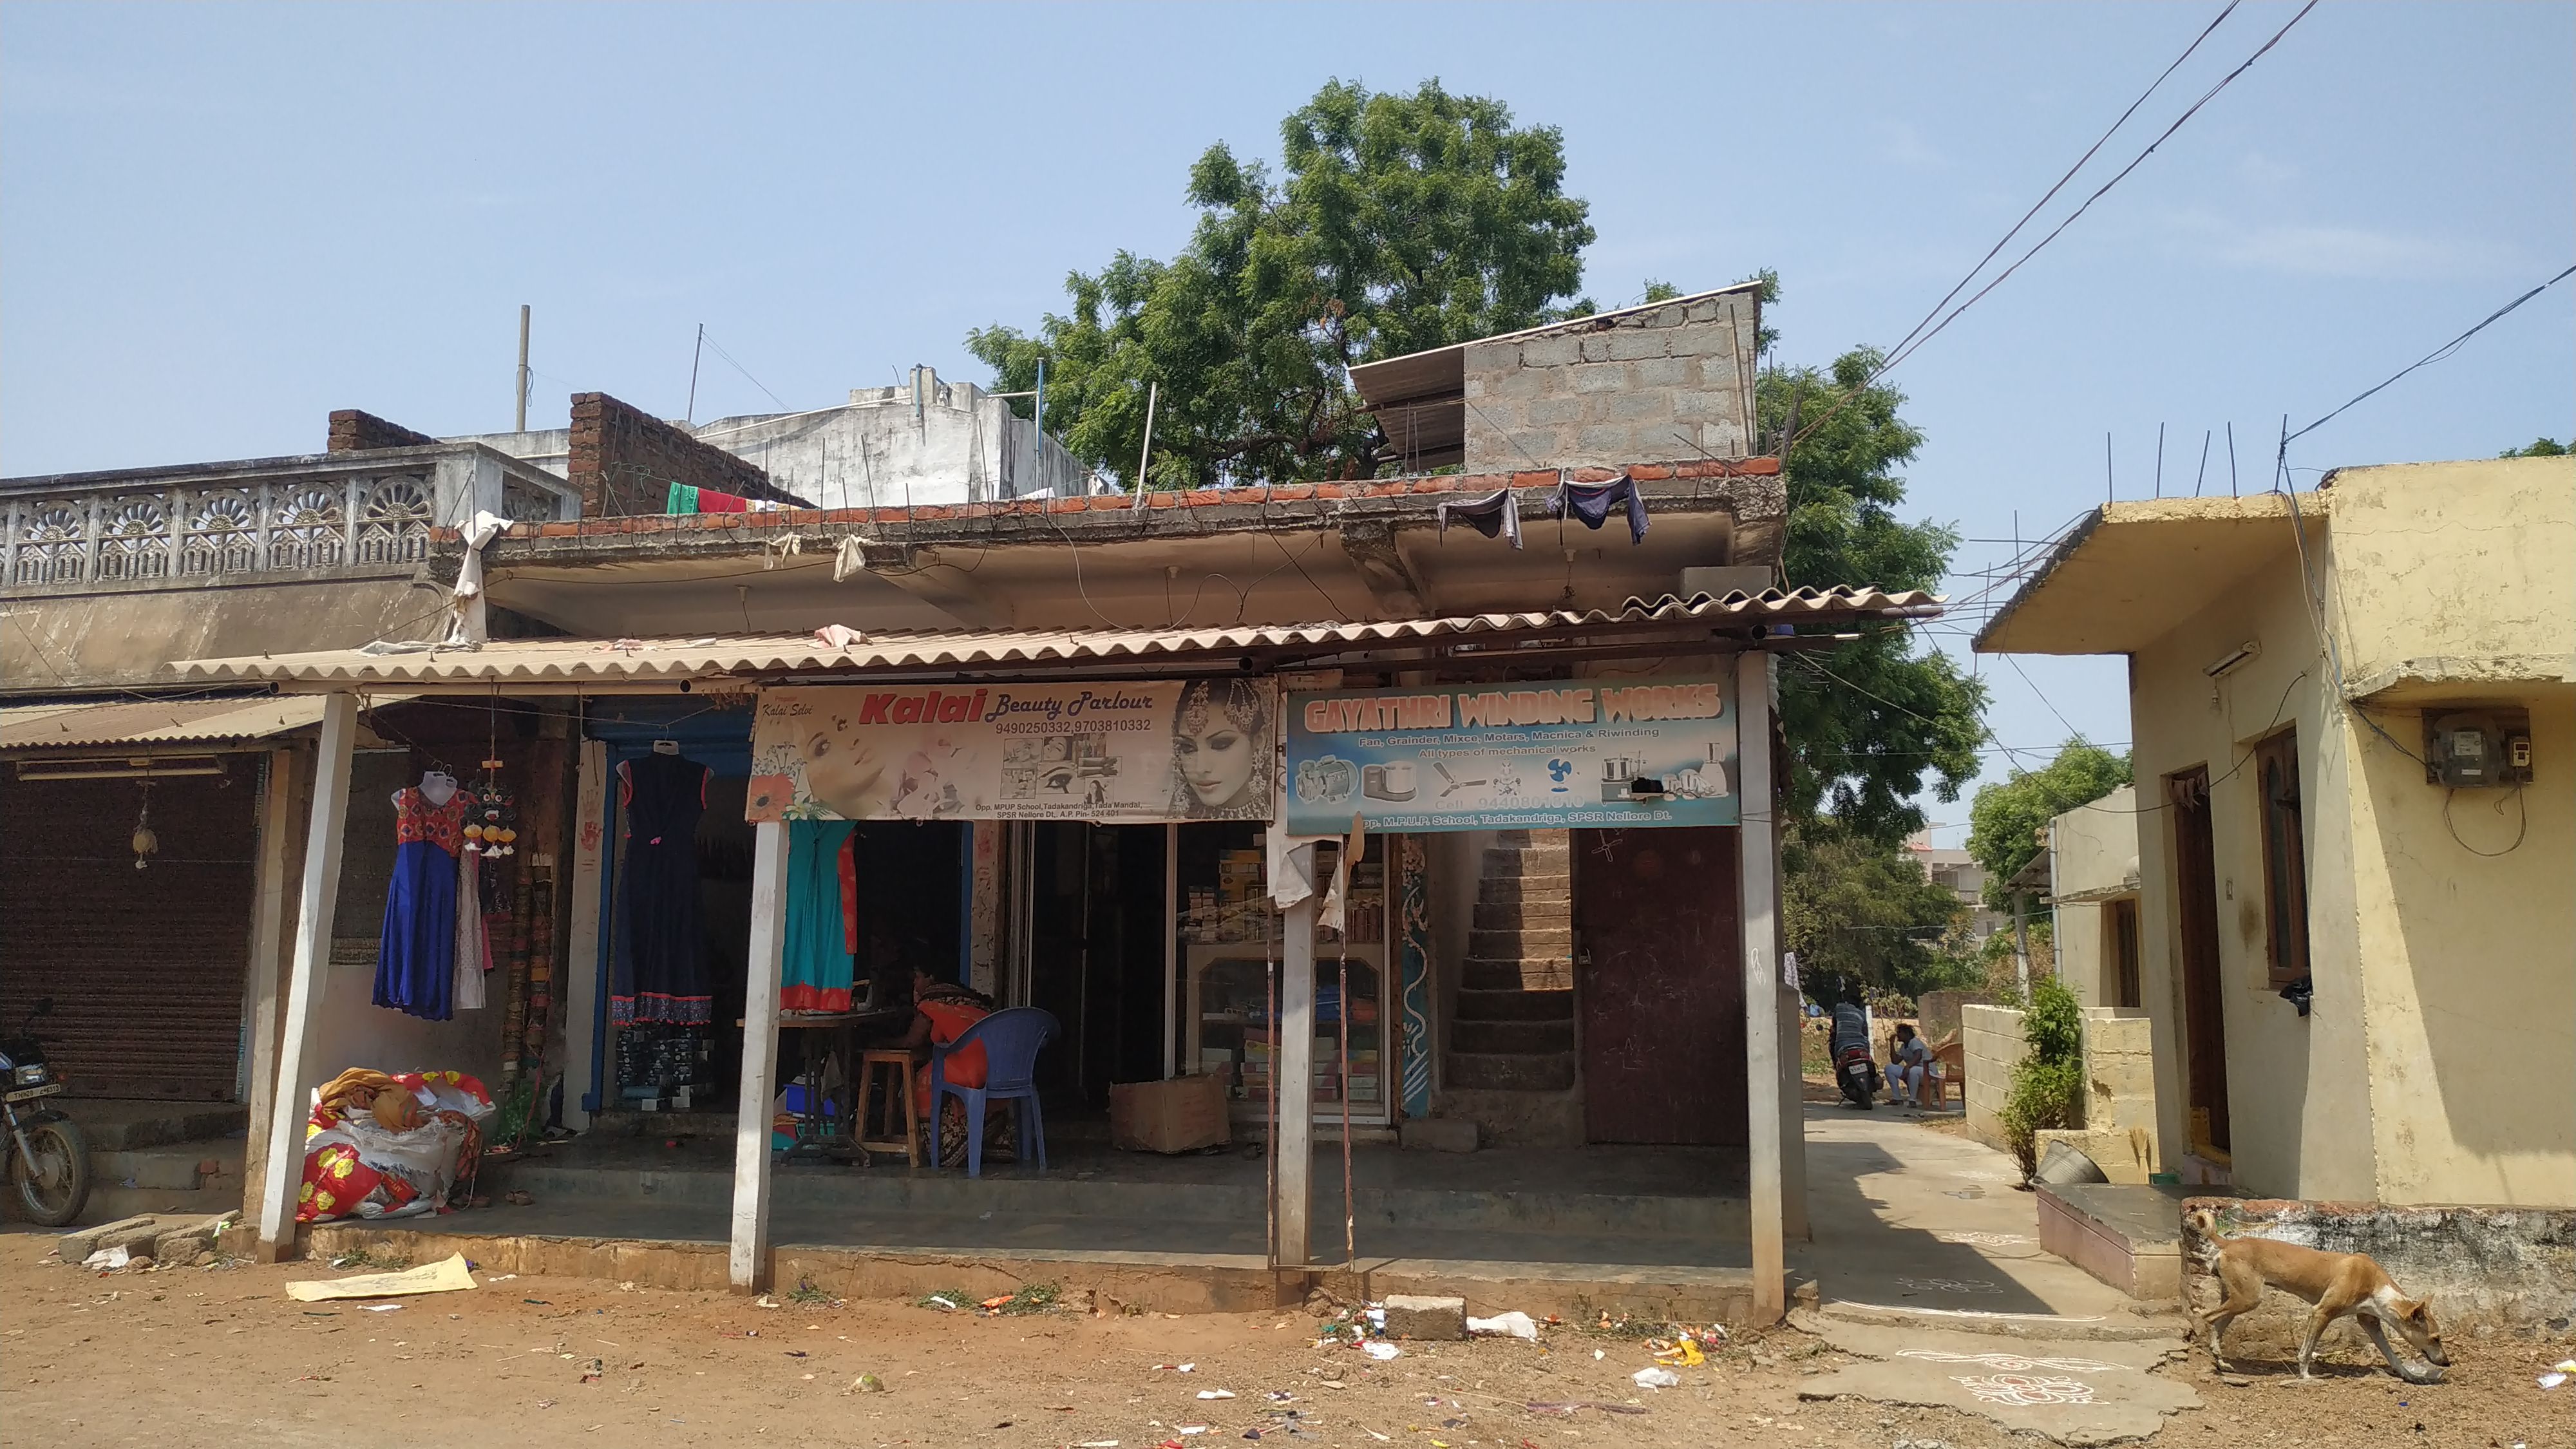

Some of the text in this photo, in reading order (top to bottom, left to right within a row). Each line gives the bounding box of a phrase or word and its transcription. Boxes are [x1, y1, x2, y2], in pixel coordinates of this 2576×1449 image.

[762, 703, 813, 717] Kalai Selvi
[858, 688, 1153, 724] Kalai Beauty Parlour
[1305, 683, 1723, 733] GAYATHRI WINDING WORKS
[1359, 728, 1660, 747] Fan, Grainder, Mixce, Motars, Macnica & Riwinding
[1419, 744, 1596, 759] All types of mechanical works
[1384, 816, 1430, 828] M.P.U.P.
[1432, 815, 1478, 826] School,
[1481, 813, 1565, 826] Tadakandriga,
[1568, 812, 1604, 822] SPSR
[1607, 811, 1651, 822] Nellore
[1653, 811, 1672, 820] Dt.
